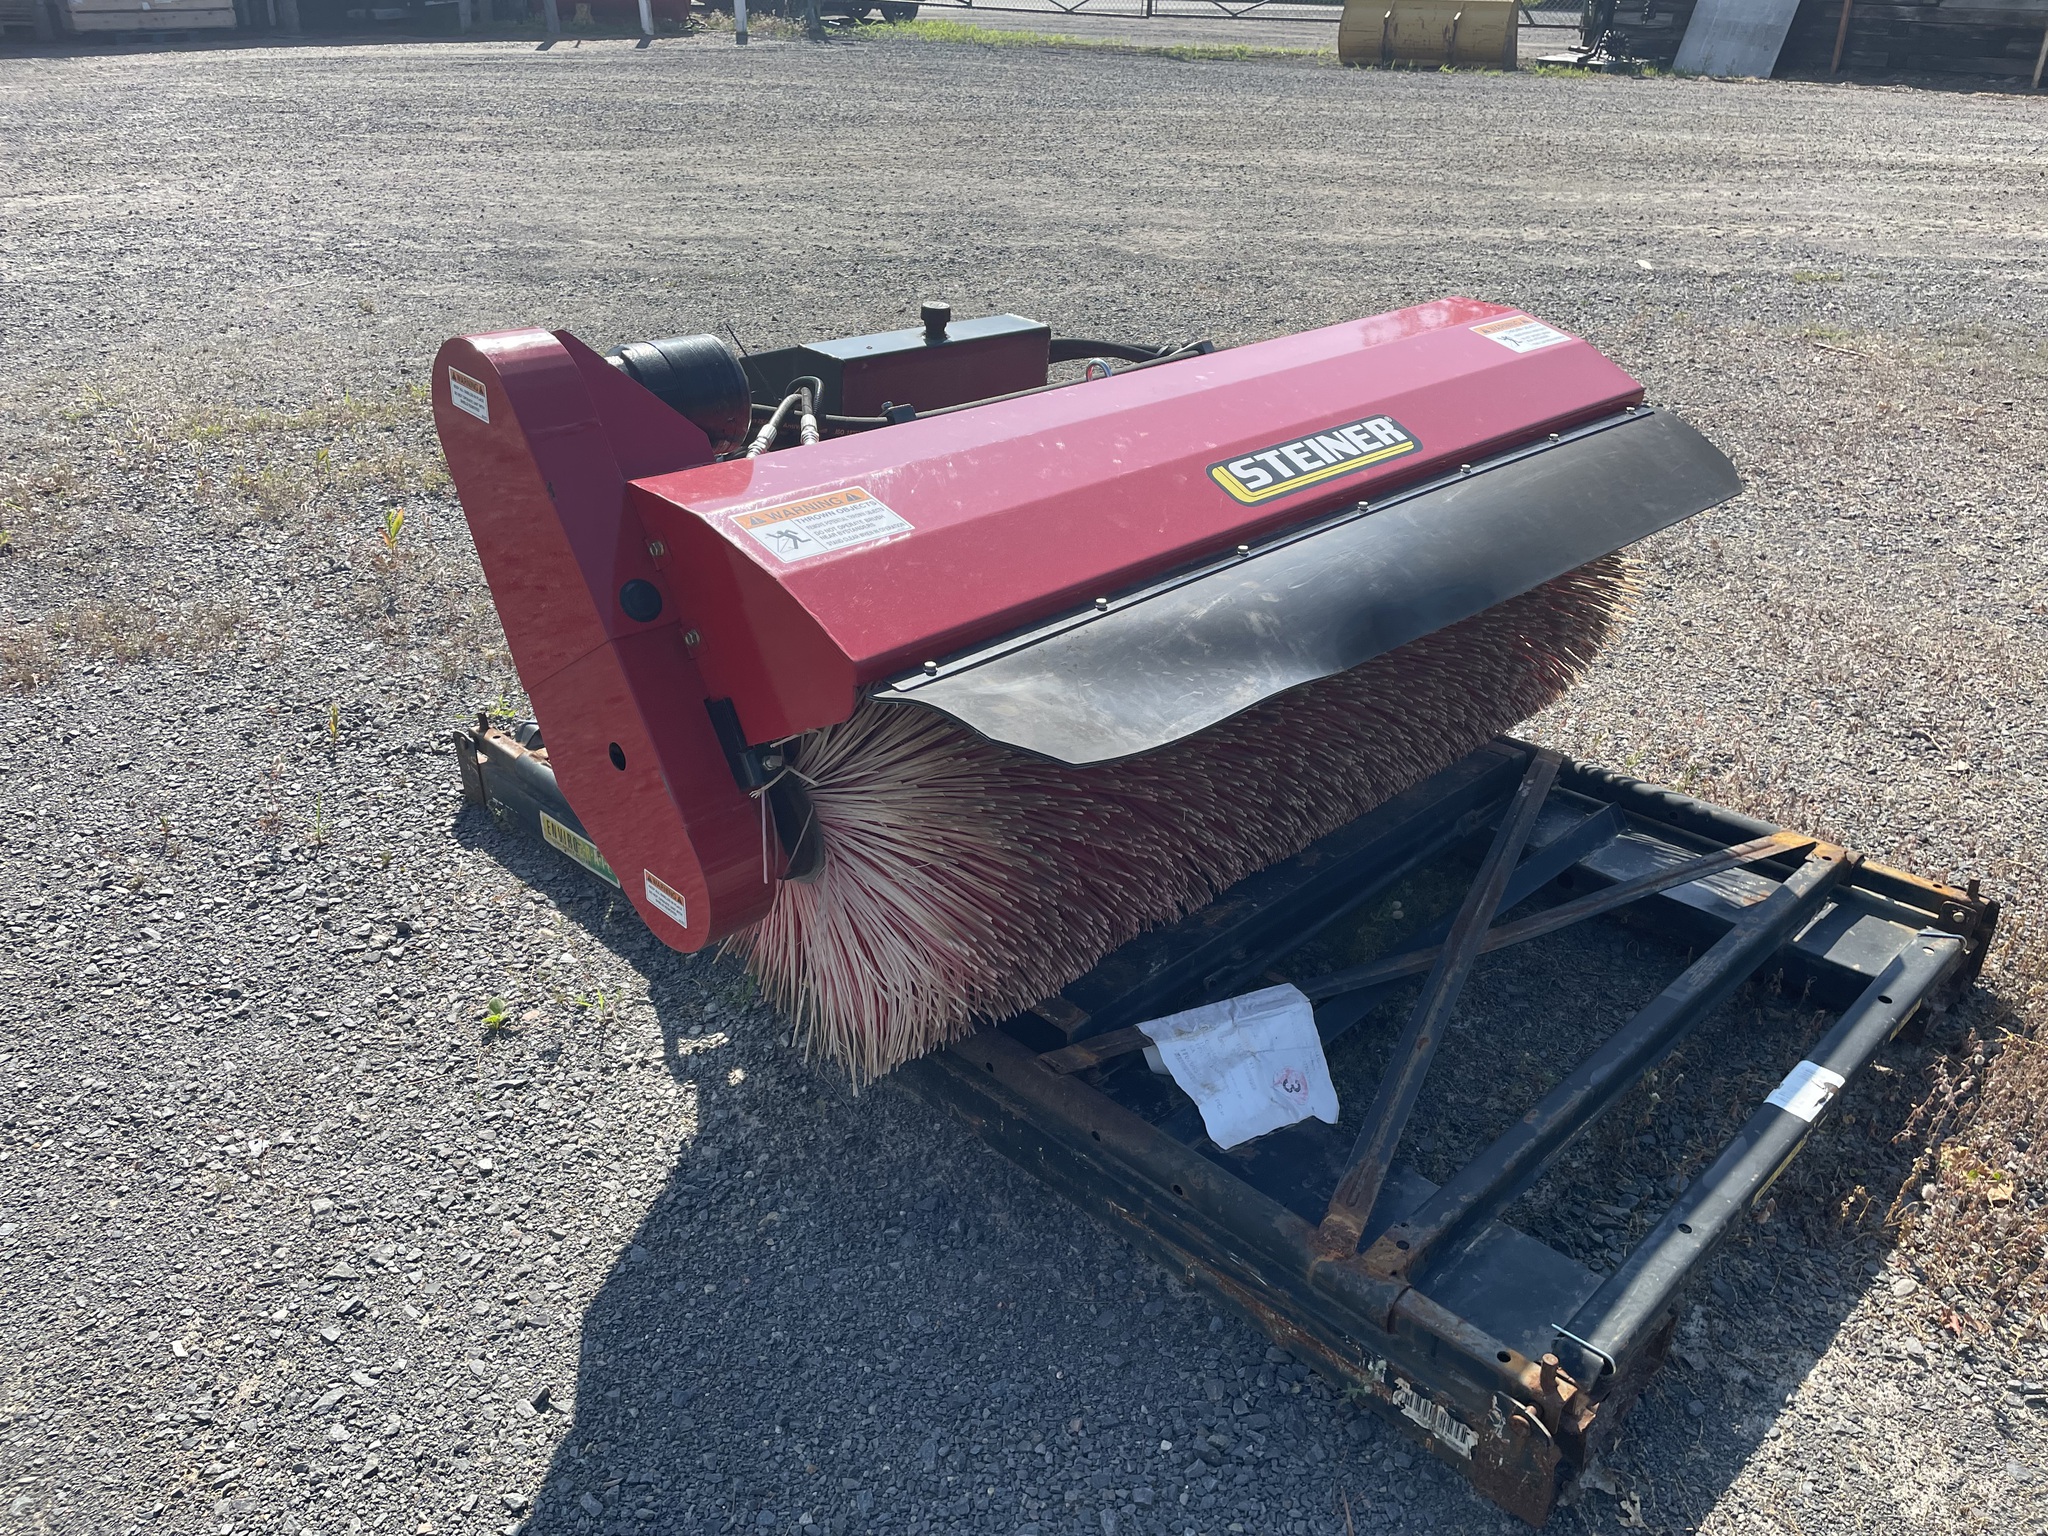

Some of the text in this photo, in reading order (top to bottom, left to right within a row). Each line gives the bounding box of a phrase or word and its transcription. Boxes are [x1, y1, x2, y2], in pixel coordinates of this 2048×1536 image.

[1228, 417, 1408, 490] STEINER
[764, 496, 843, 521] WARNING
[794, 500, 878, 524] THROWN OBJECTS
